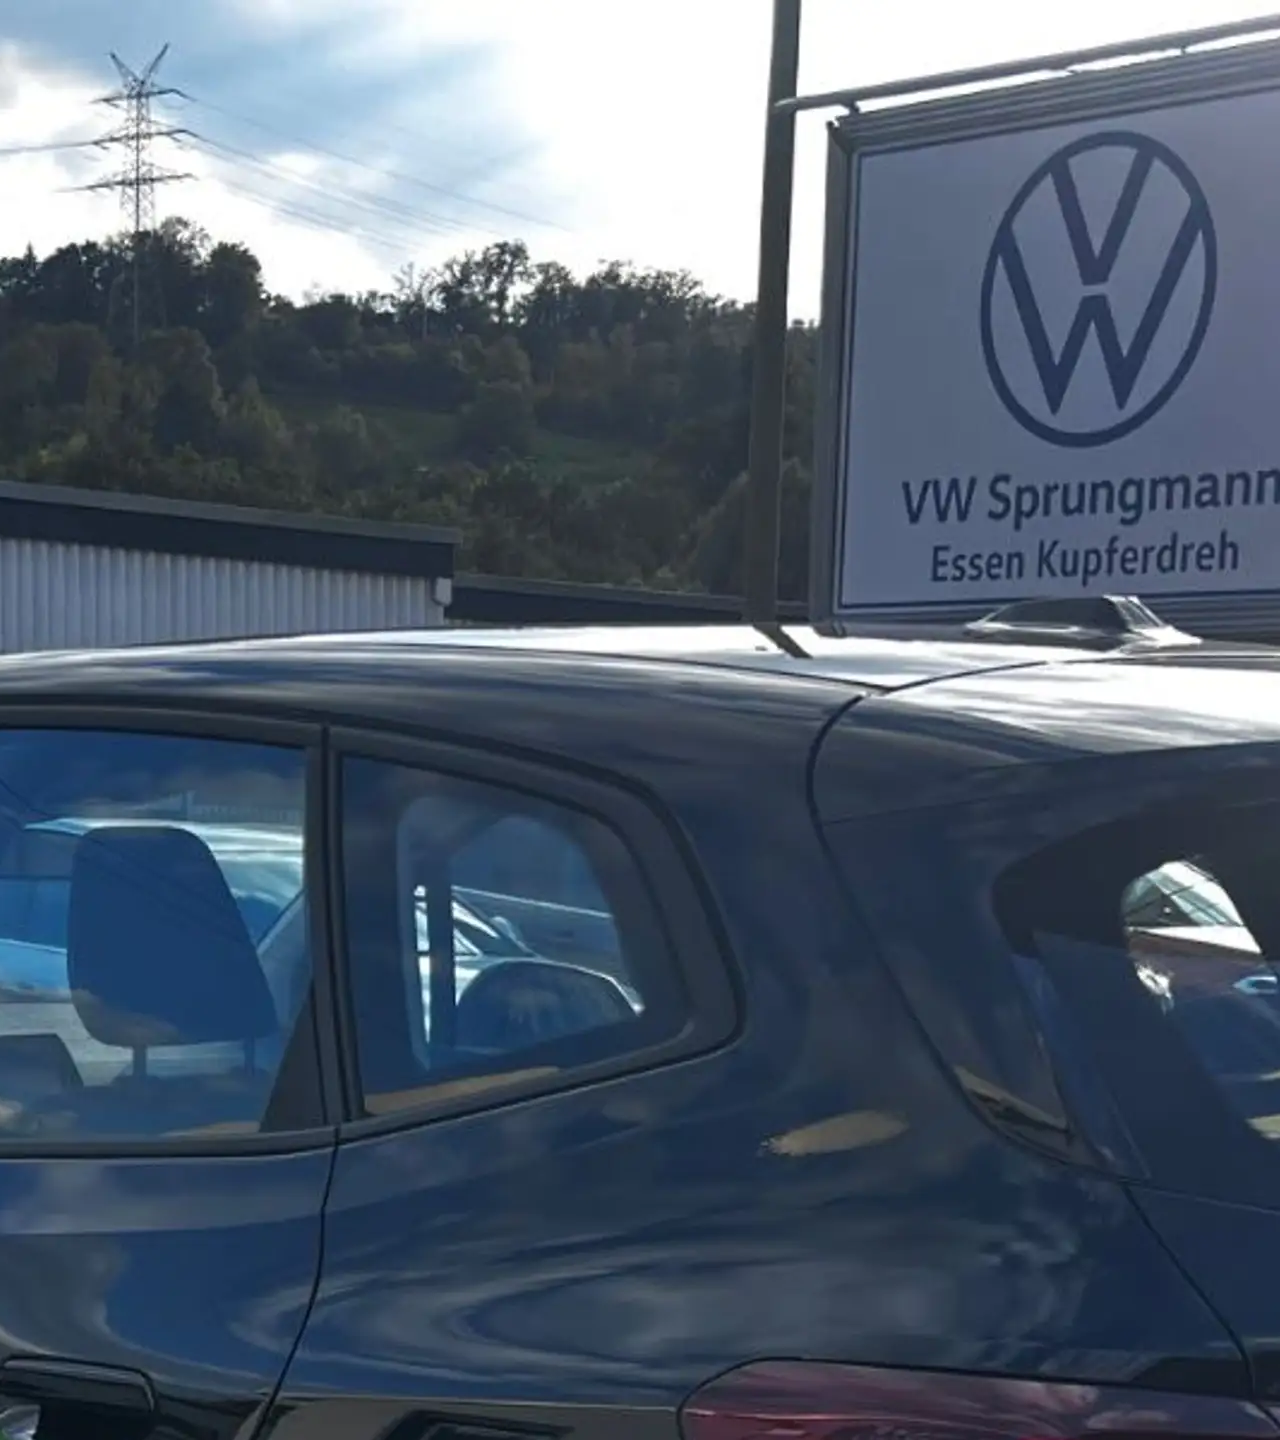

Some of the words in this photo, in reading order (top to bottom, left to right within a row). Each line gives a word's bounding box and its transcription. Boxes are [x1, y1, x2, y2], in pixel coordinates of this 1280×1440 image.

[902, 479, 976, 525] VW
[930, 543, 1024, 582] Essen
[1036, 530, 1240, 586] Kupferdreh
